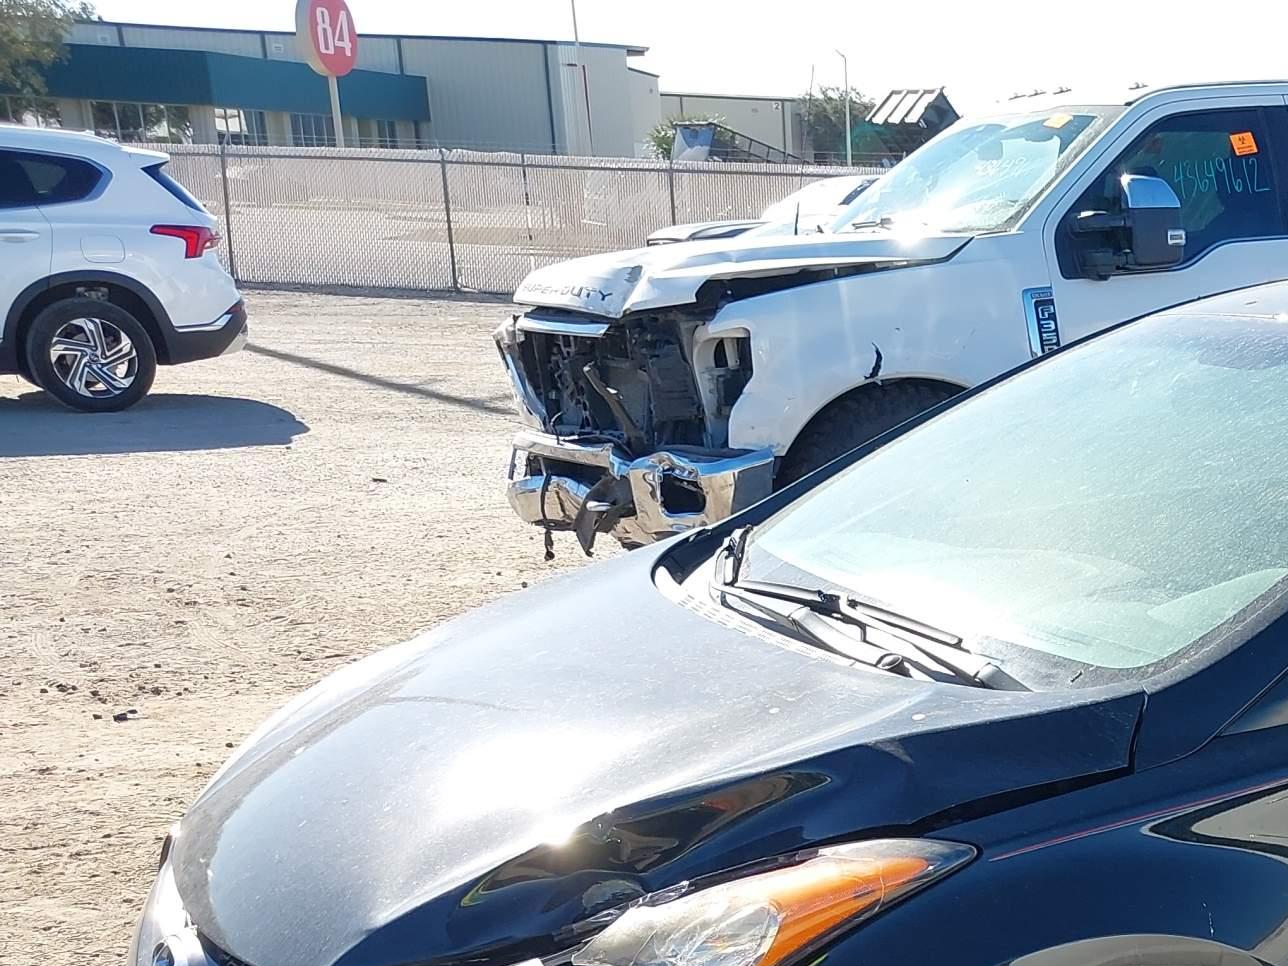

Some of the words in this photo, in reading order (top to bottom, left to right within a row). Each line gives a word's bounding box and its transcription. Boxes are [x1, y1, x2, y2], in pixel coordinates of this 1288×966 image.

[316, 7, 352, 57] 84
[1174, 157, 1271, 198] 43649612
[560, 286, 612, 301] DUTY
